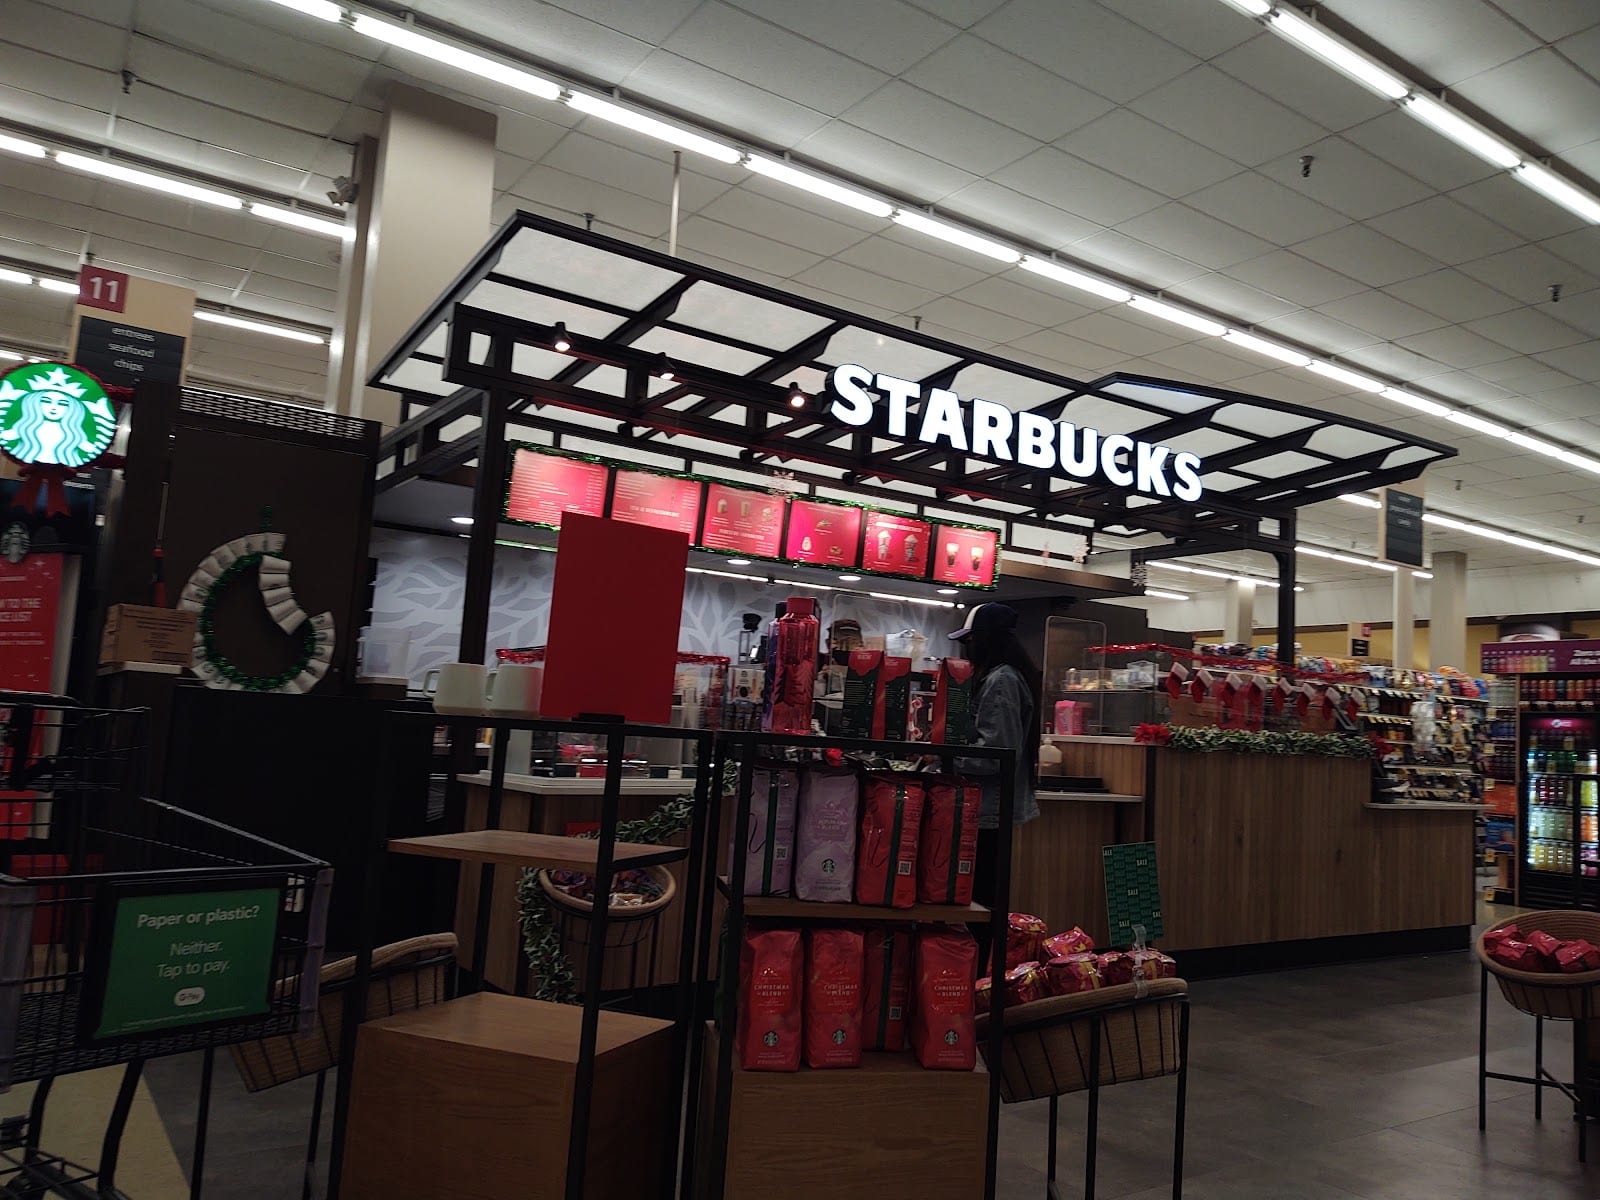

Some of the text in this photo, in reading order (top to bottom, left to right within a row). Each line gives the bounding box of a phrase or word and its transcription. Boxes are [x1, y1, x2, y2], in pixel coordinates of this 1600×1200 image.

[90, 276, 119, 303] 11
[112, 328, 154, 342] entrees
[108, 344, 154, 358] seafood
[114, 359, 144, 372] chips
[831, 364, 1203, 502] STARBUCKS
[136, 905, 261, 930] Paper or plastic?
[169, 940, 223, 957] Neither.
[156, 959, 231, 980] Tap to pay.
